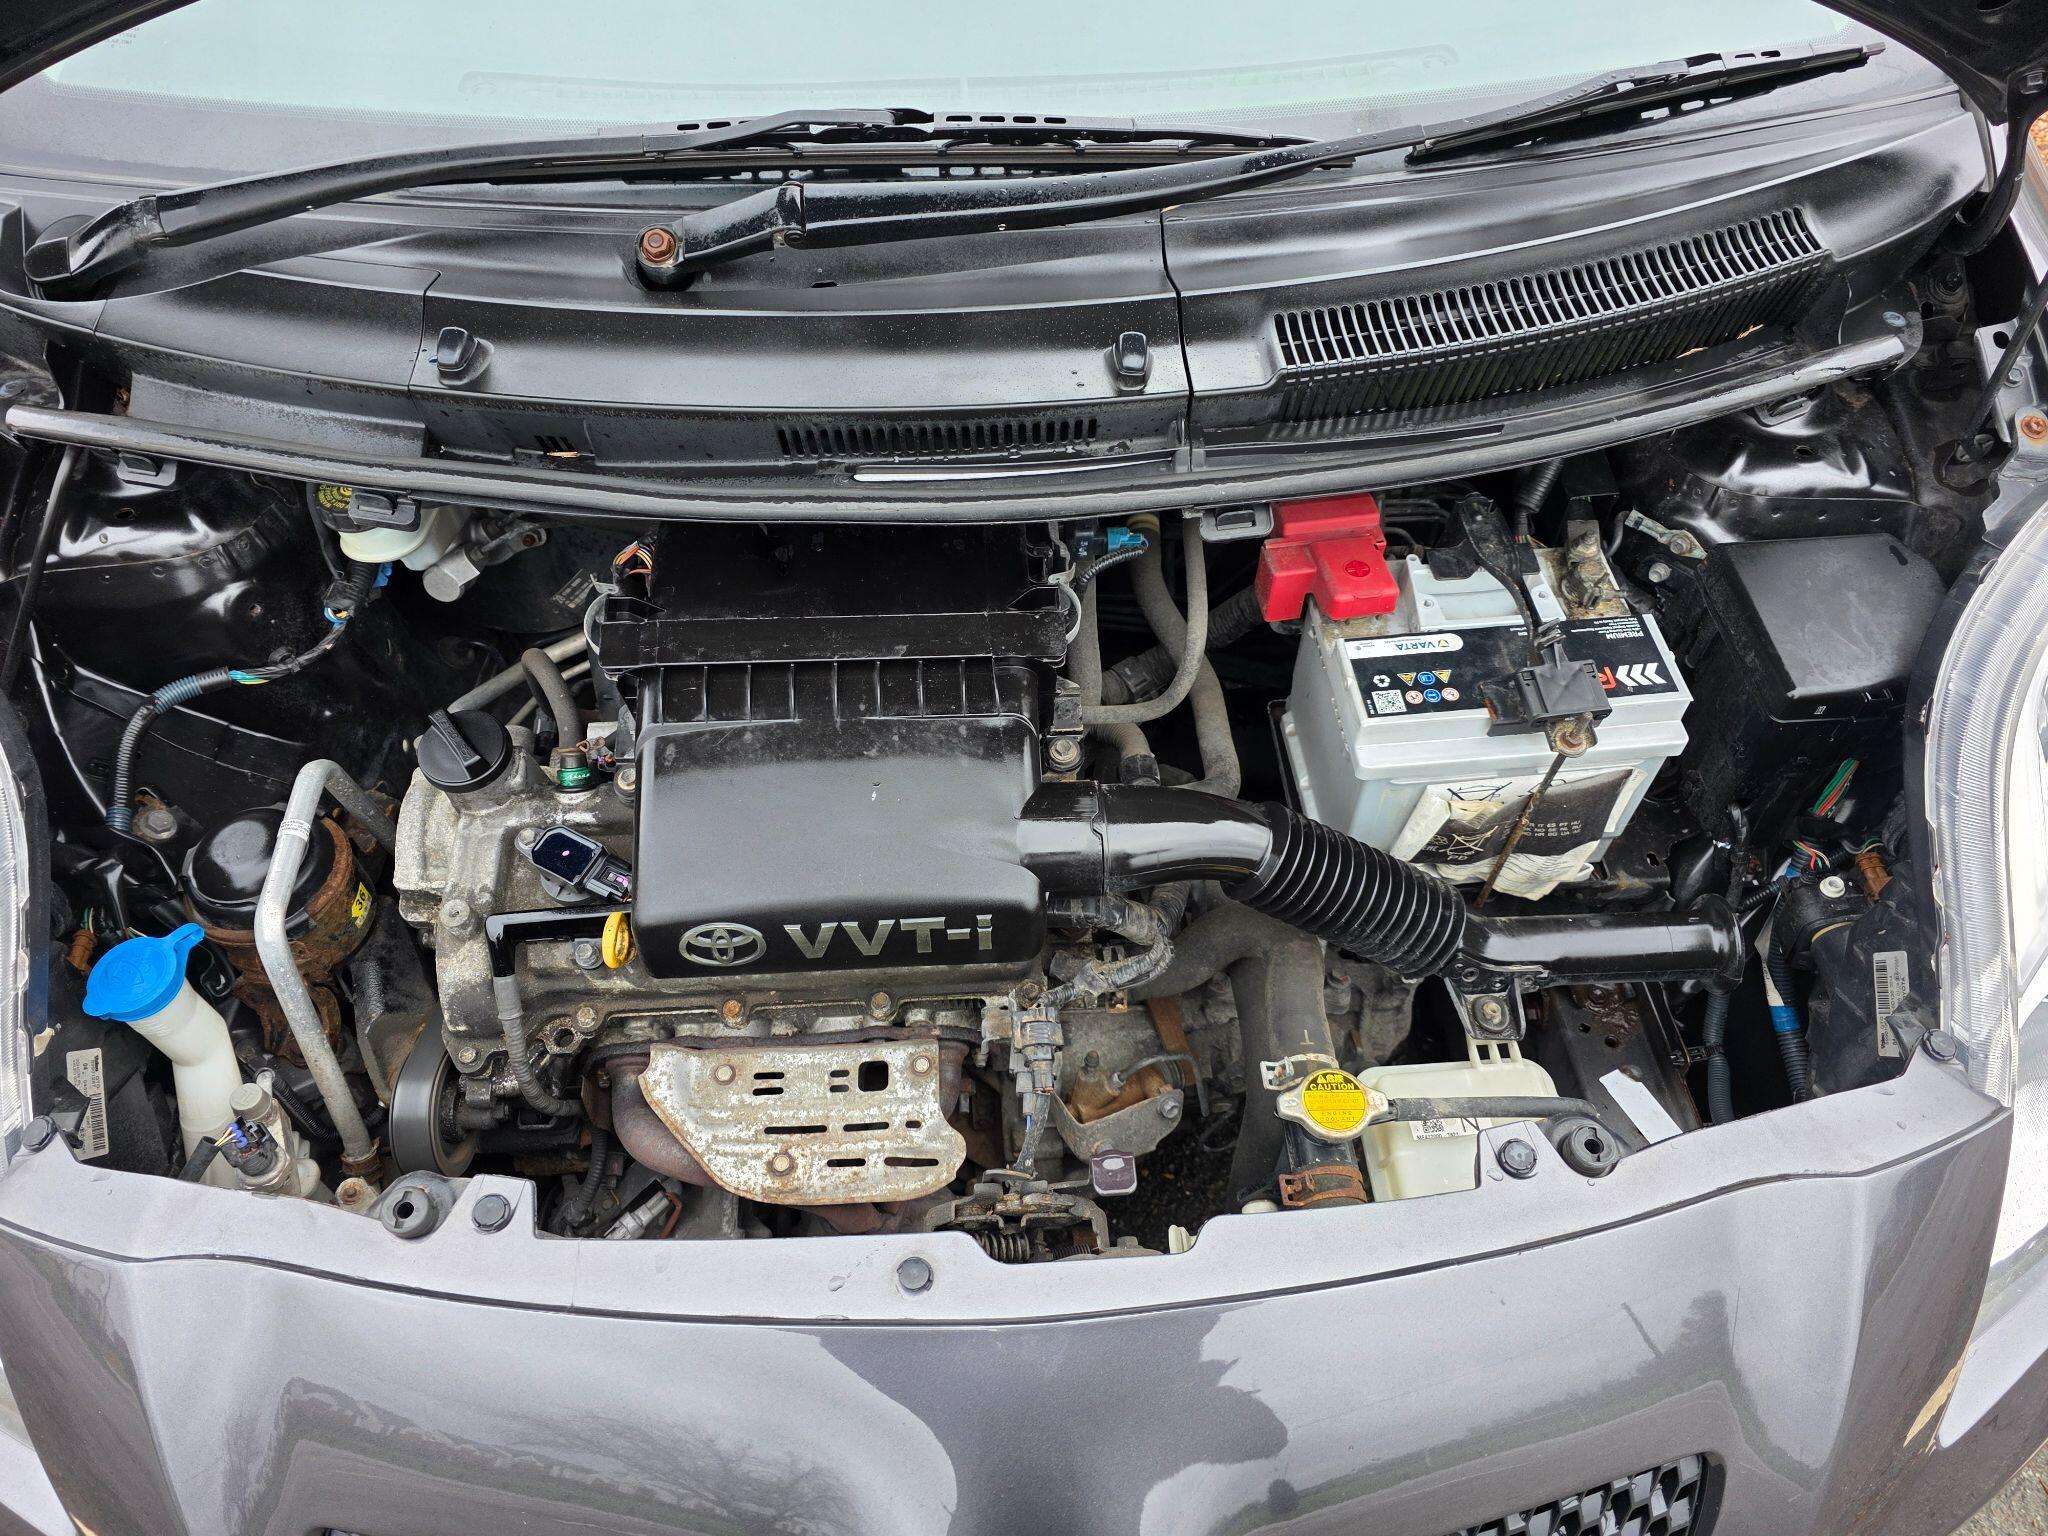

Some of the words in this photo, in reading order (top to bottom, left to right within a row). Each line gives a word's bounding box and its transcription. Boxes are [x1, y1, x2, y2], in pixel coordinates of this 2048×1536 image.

[1605, 630, 1644, 640] PREMIUM
[1395, 641, 1436, 651] VARTA
[783, 913, 992, 959] VVT-i
